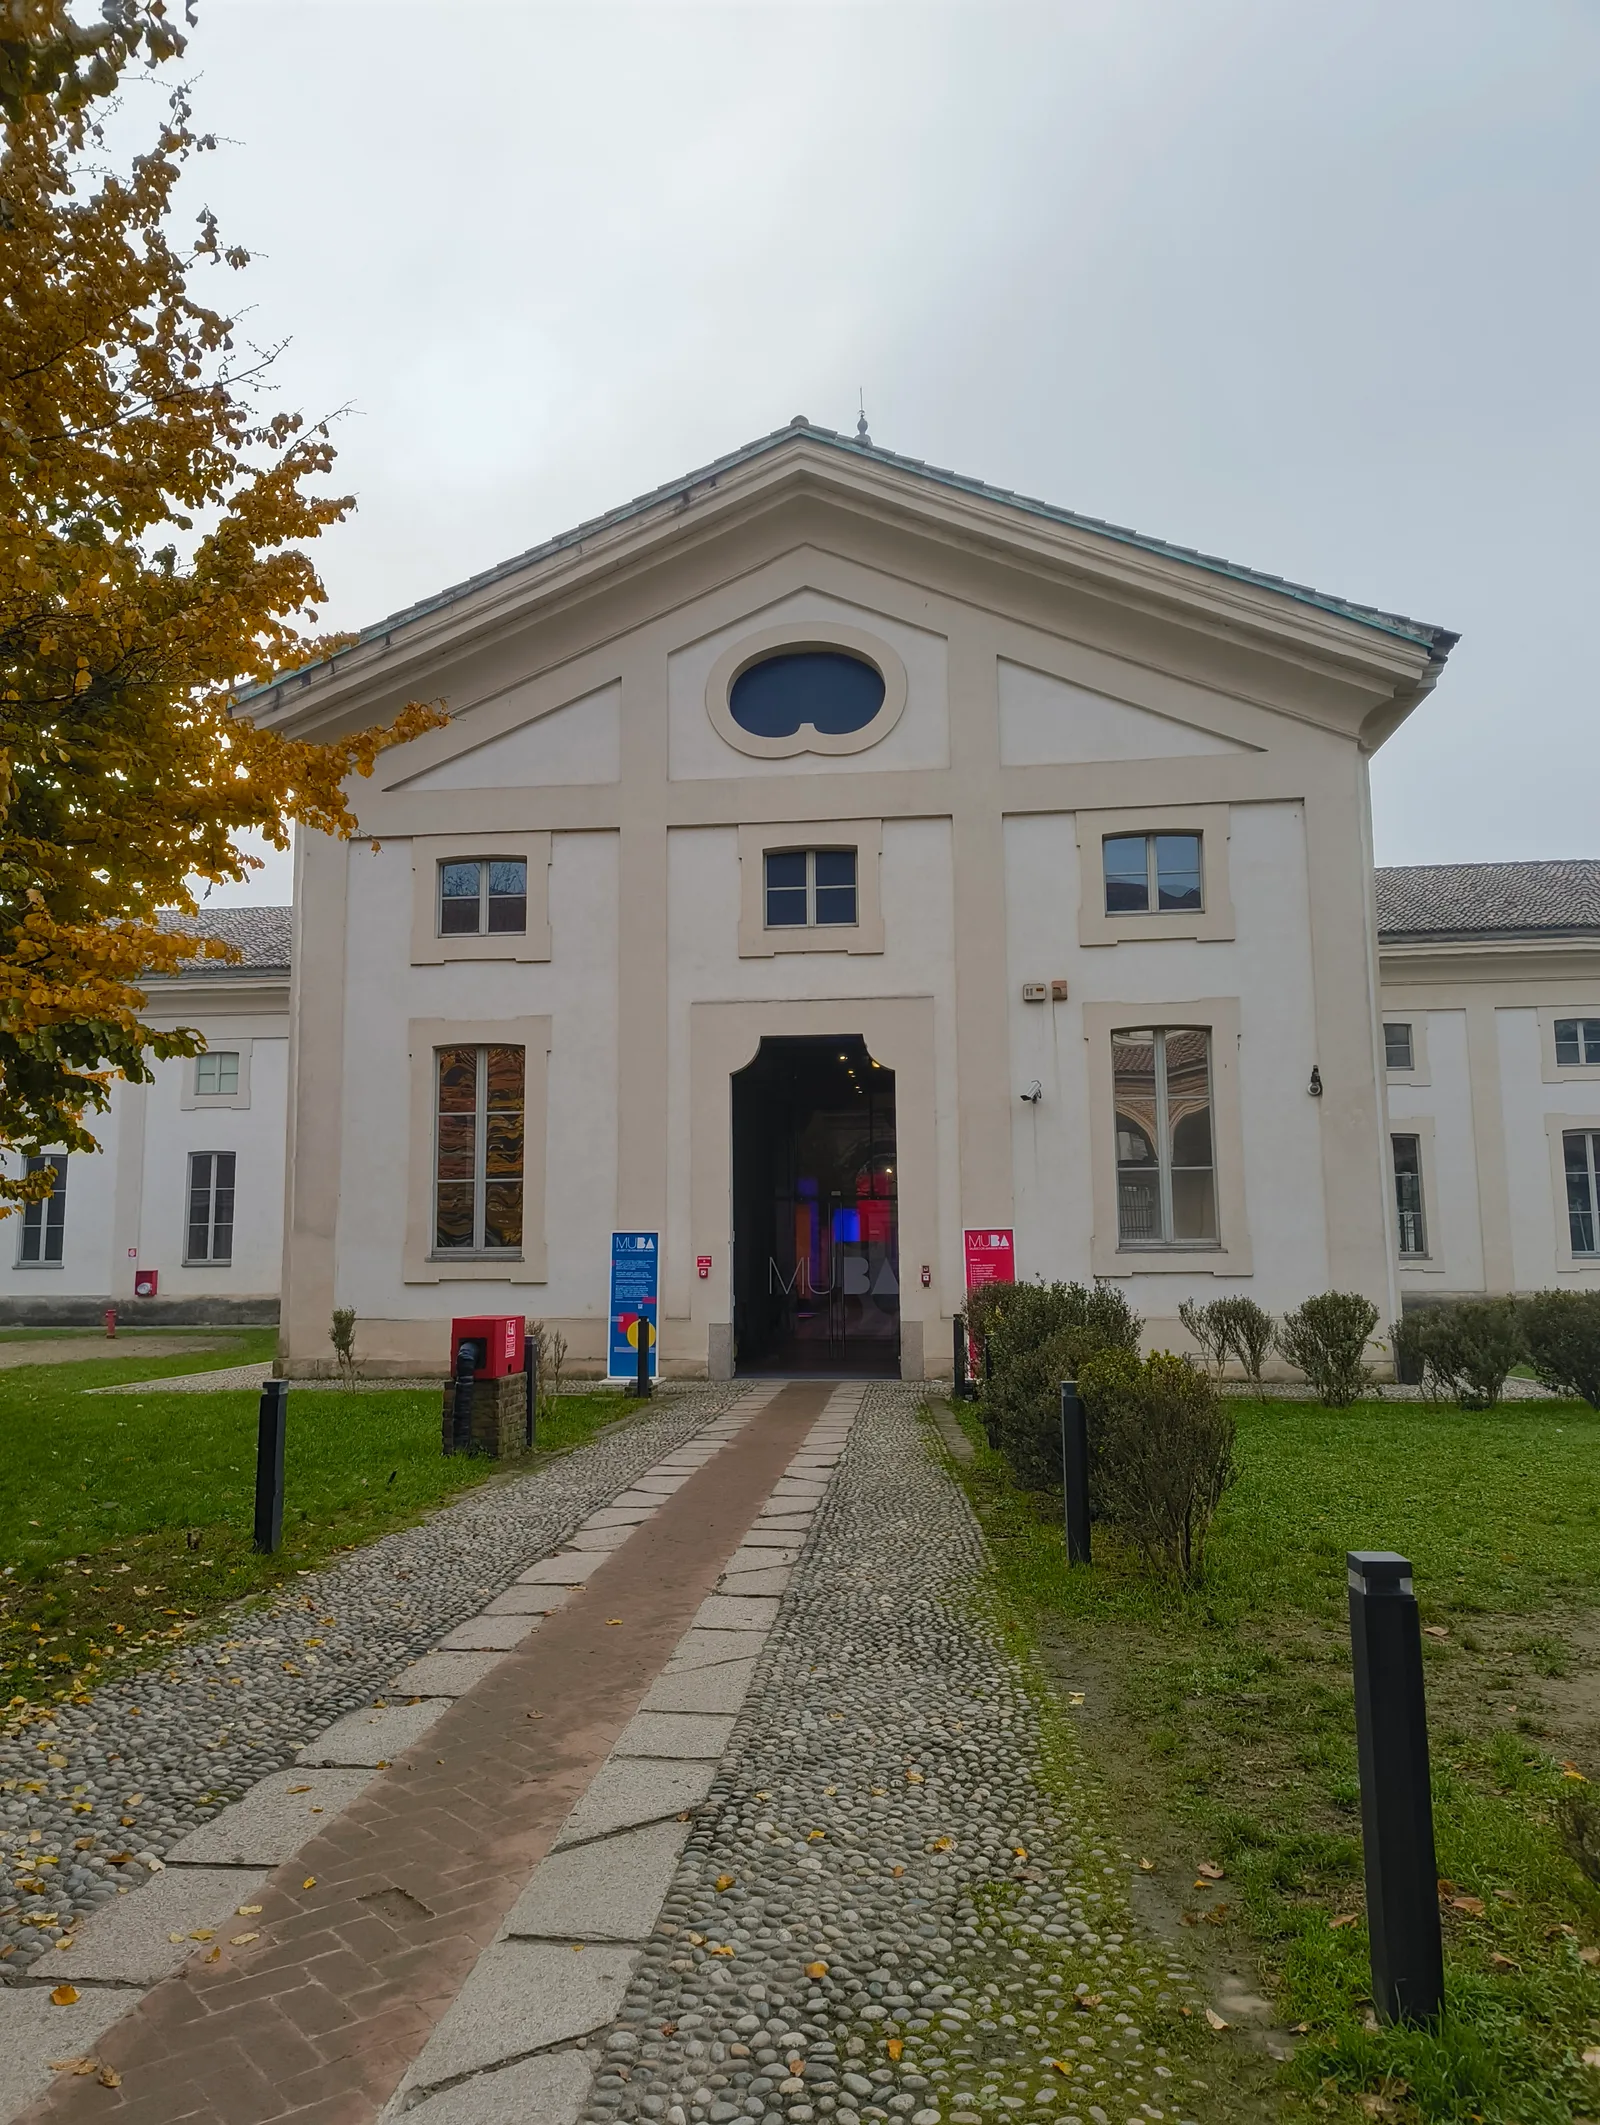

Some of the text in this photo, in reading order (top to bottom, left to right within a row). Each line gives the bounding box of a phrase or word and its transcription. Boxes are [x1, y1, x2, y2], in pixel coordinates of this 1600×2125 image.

[616, 1237, 655, 1249] MUBA
[968, 1234, 1009, 1247] MUBA
[768, 1256, 899, 1295] MUBA
